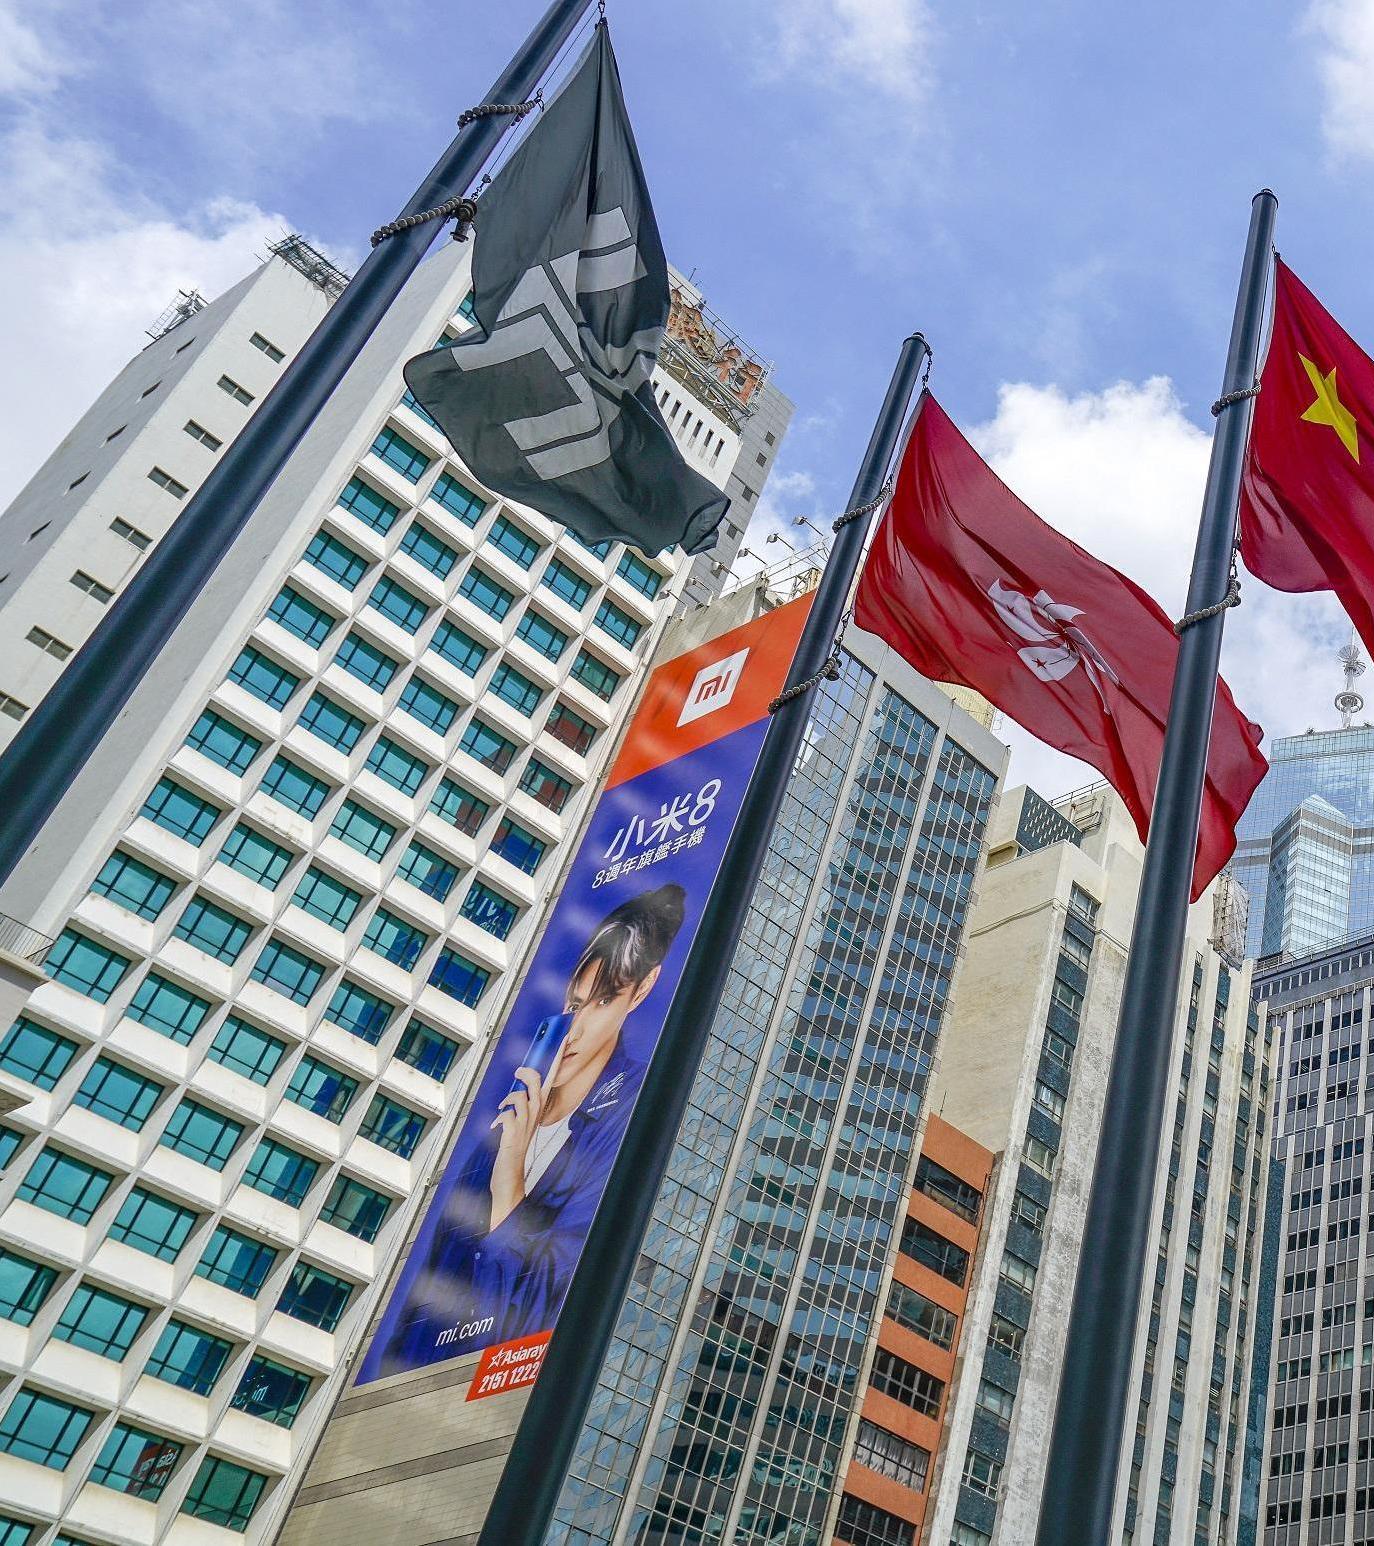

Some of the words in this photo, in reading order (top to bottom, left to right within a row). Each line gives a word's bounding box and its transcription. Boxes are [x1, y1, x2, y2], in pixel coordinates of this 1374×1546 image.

[603, 779, 721, 862] 小米8
[435, 1317, 494, 1346] mi.com
[501, 1343, 549, 1366] Asiaray
[478, 1370, 509, 1393] 2151
[509, 1361, 541, 1385] 1222
